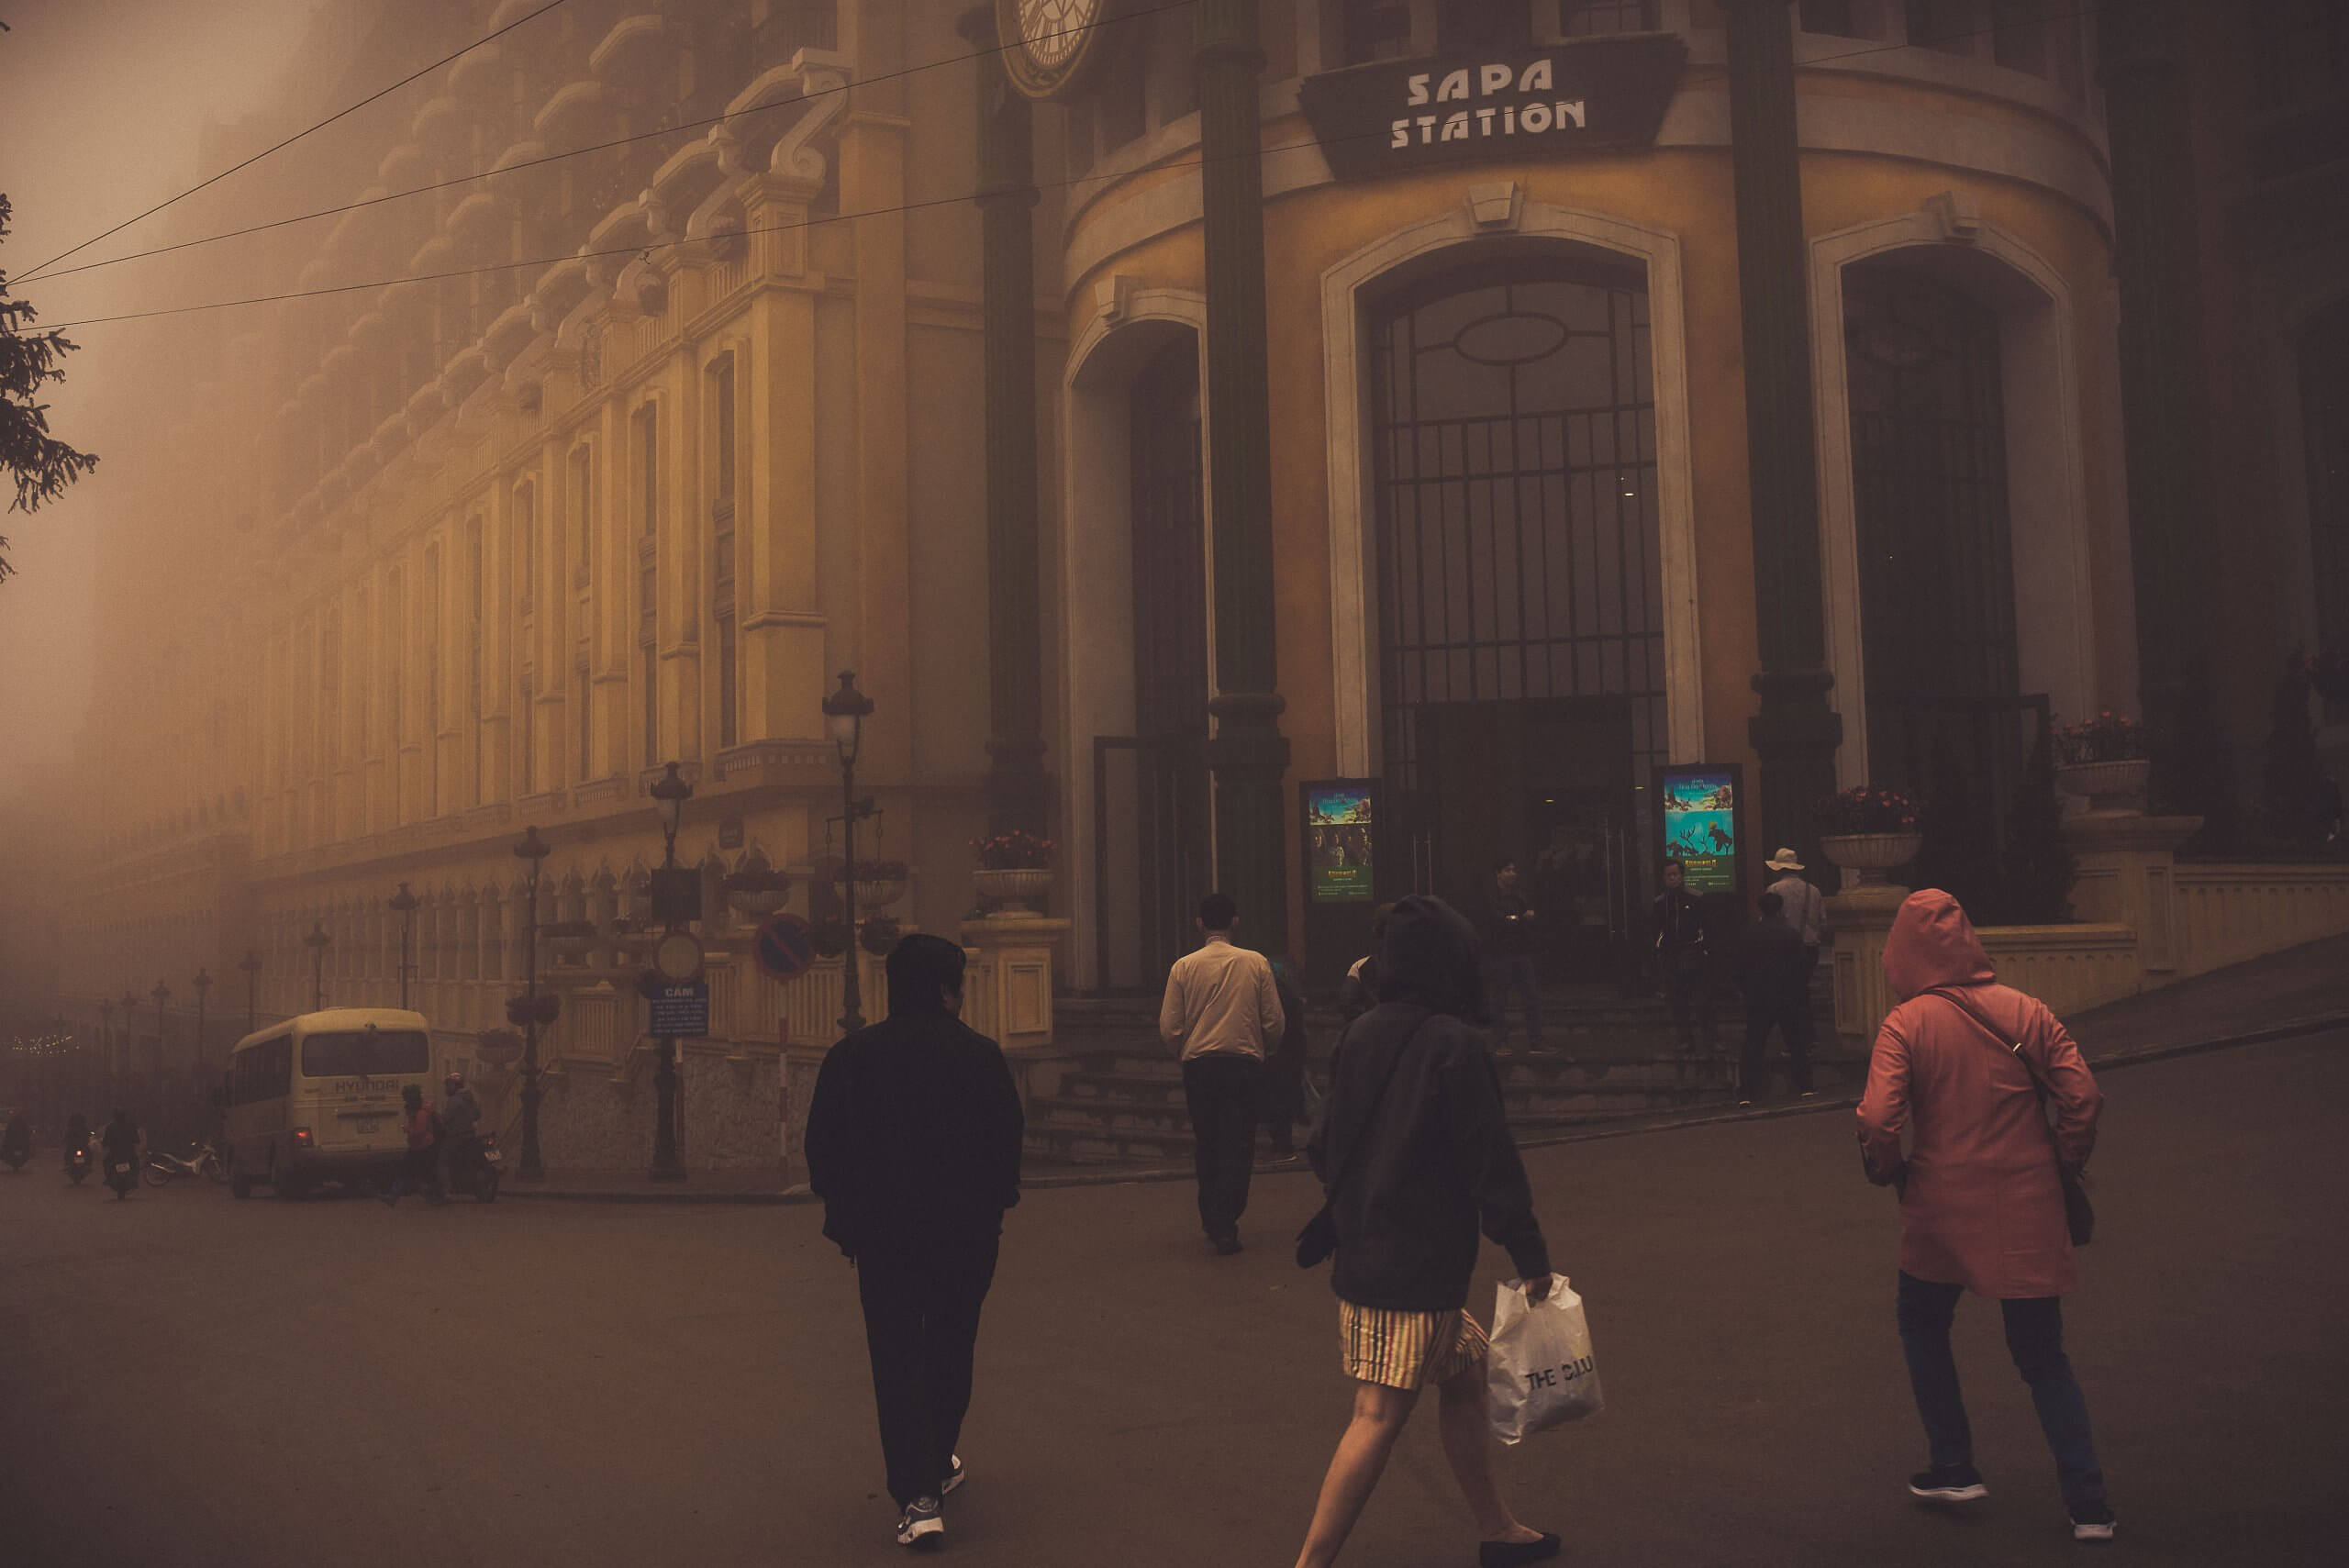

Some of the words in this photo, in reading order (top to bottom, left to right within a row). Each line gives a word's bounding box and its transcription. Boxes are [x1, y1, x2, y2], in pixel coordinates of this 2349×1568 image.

[1408, 59, 1553, 106] SAPA
[1392, 100, 1586, 149] STATION
[1525, 1369, 1556, 1391] THE
